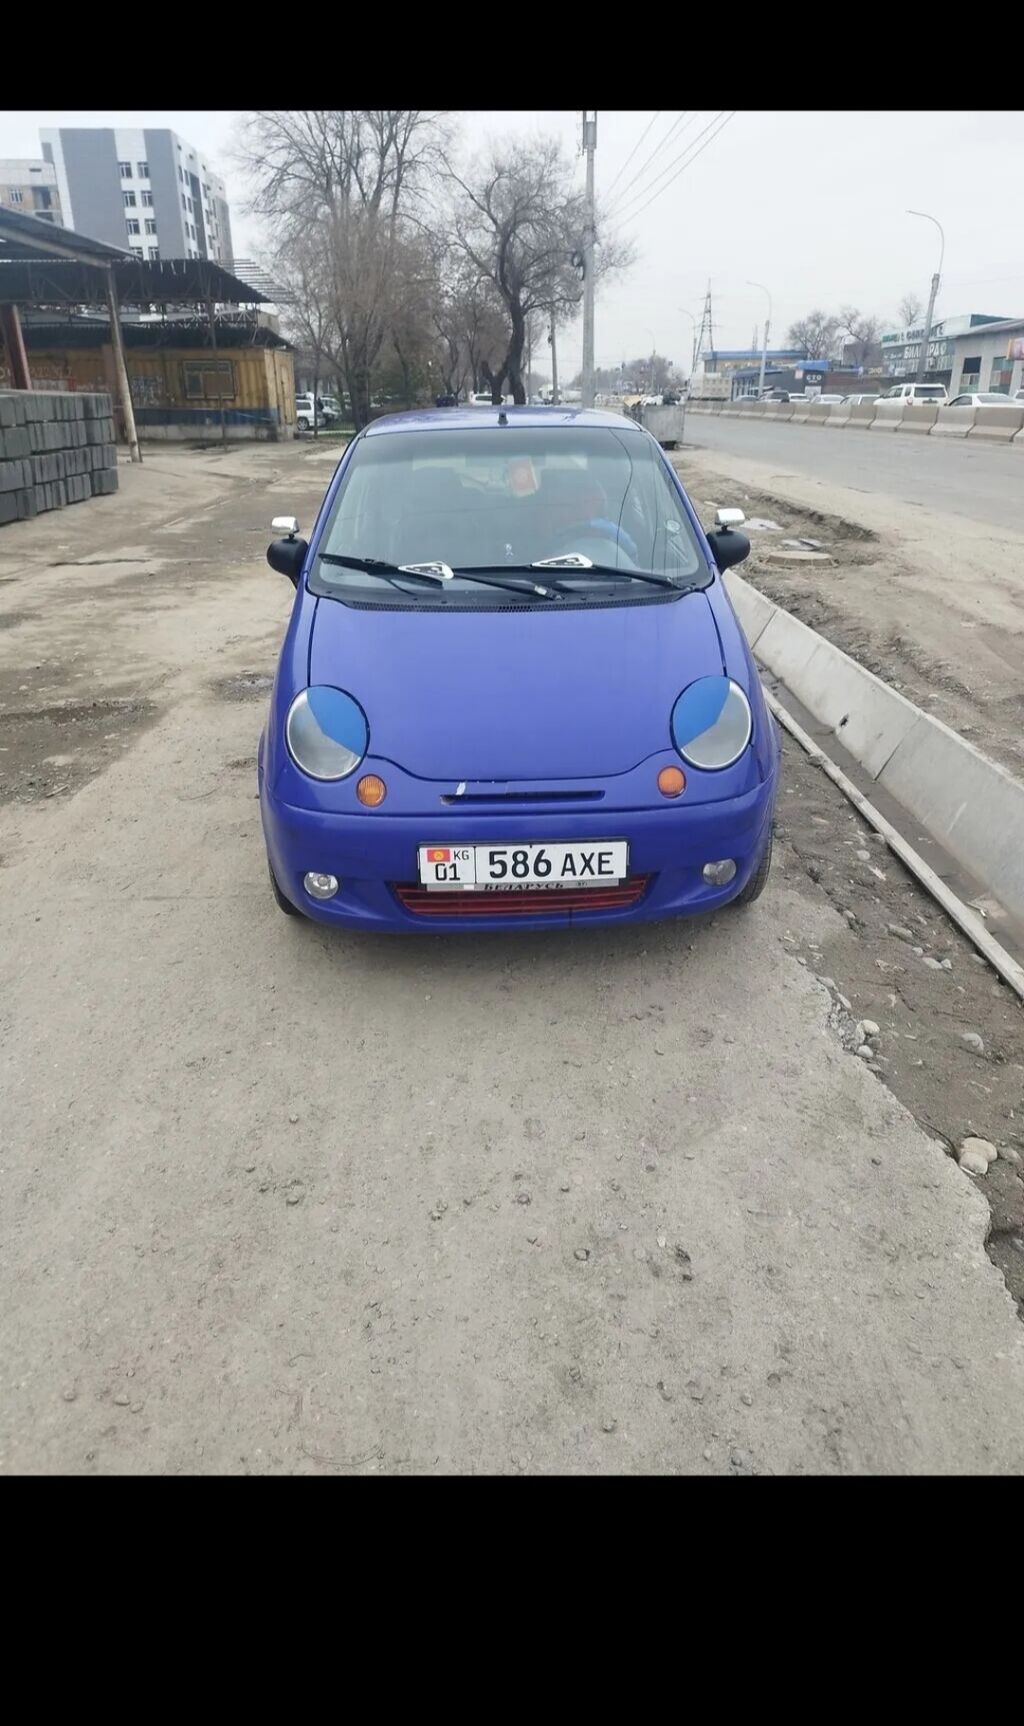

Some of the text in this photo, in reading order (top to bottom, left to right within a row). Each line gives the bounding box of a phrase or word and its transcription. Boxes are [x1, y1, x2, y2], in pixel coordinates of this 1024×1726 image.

[453, 849, 470, 861] KG
[488, 849, 614, 879] 586 AXE
[435, 862, 461, 881] 01
